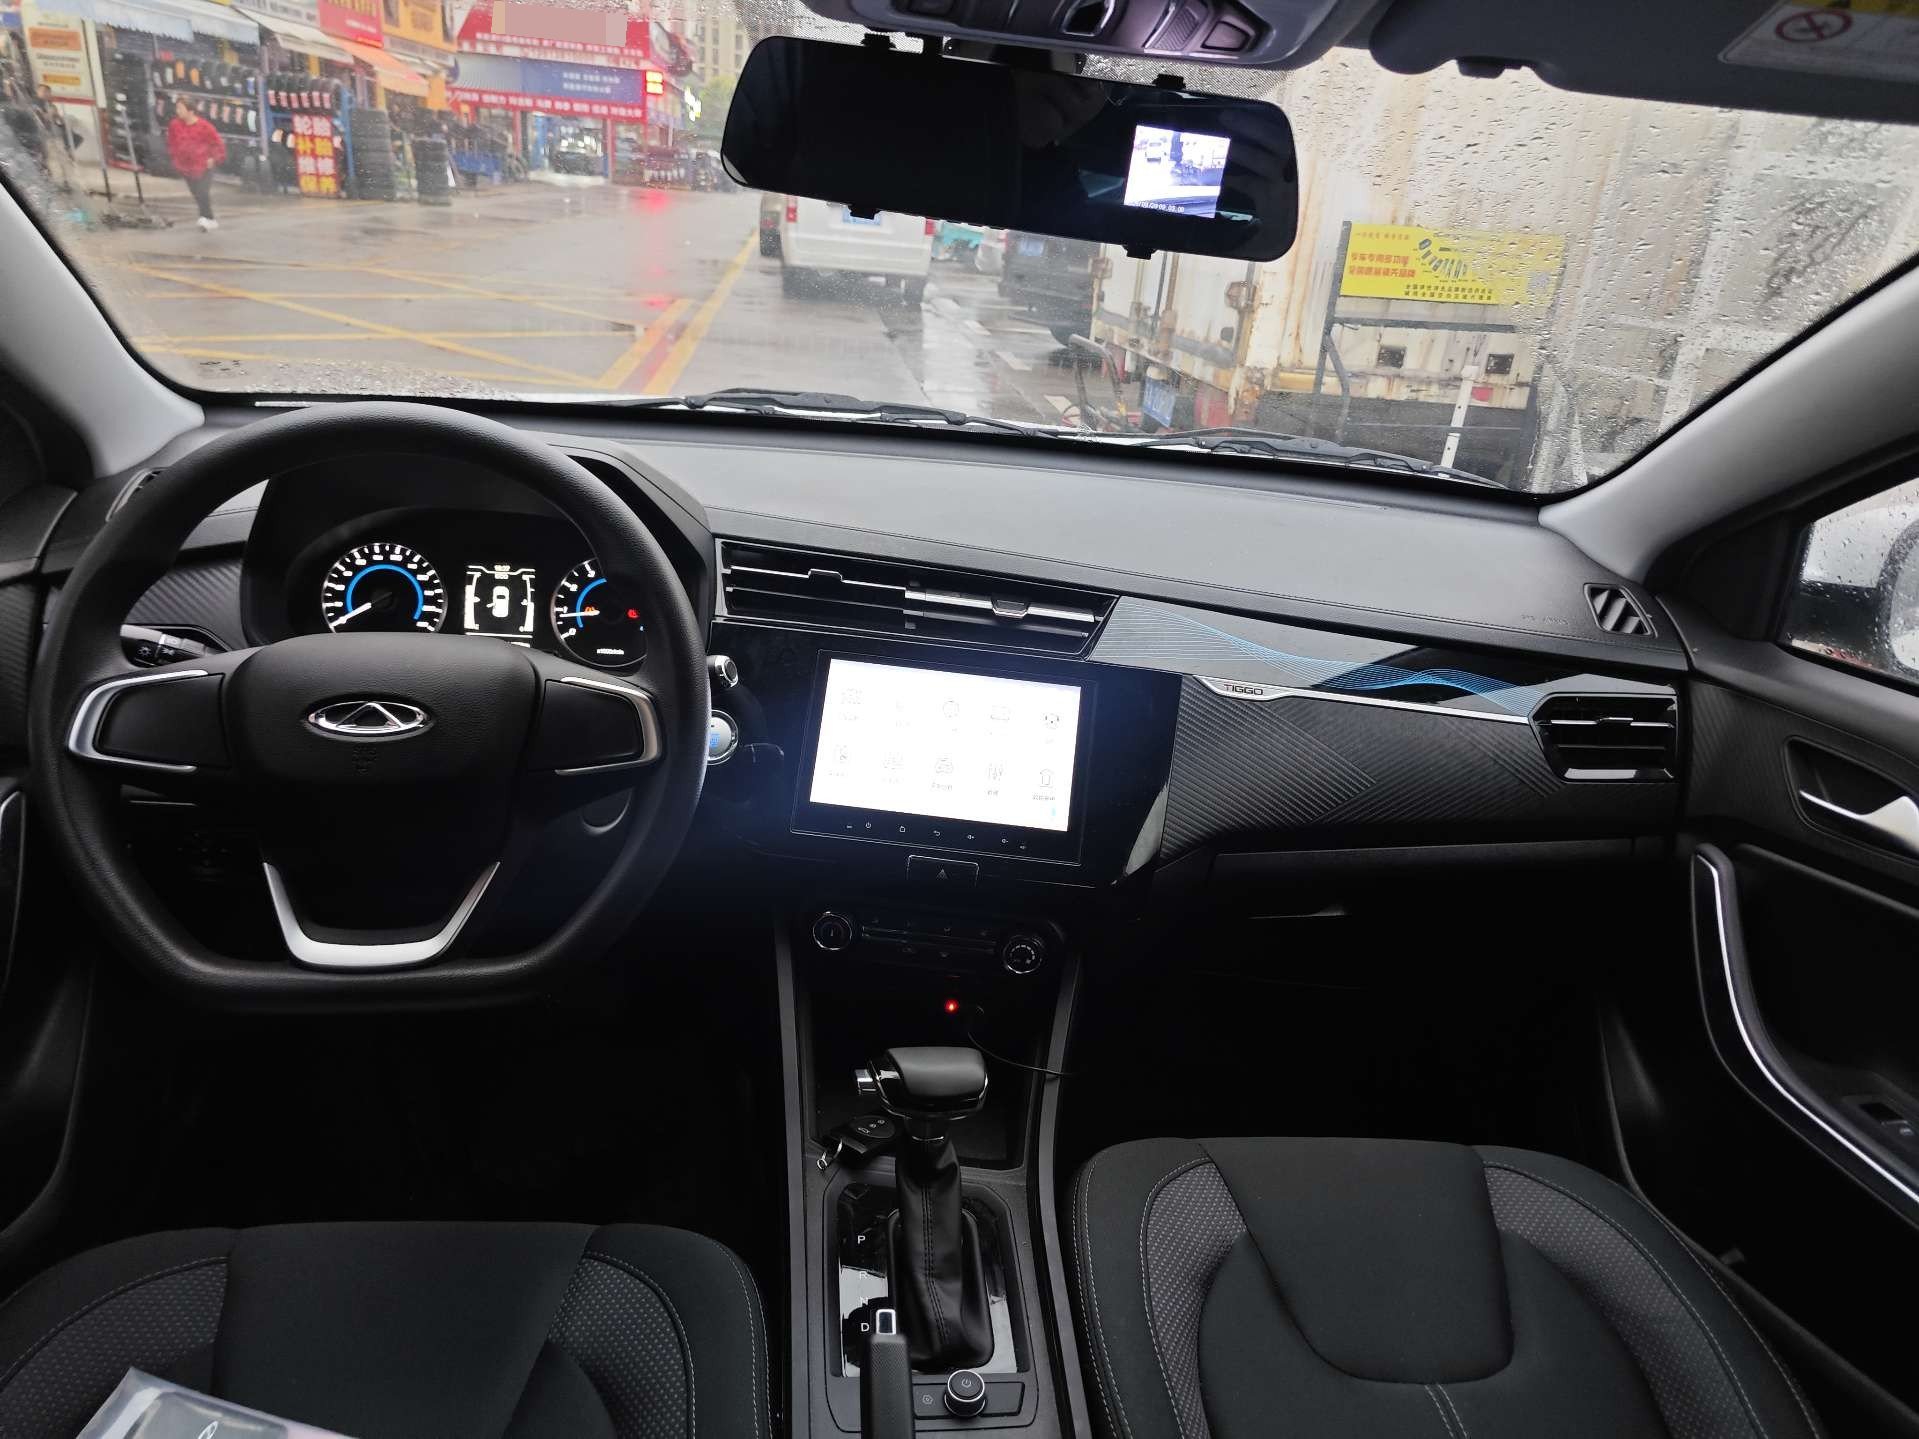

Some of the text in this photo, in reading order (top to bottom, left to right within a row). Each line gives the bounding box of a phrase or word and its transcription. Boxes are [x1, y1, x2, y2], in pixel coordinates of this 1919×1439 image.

[1223, 684, 1264, 695] TIGGO
[857, 1235, 866, 1244] P
[860, 1270, 869, 1280] R
[860, 1322, 870, 1332] D
